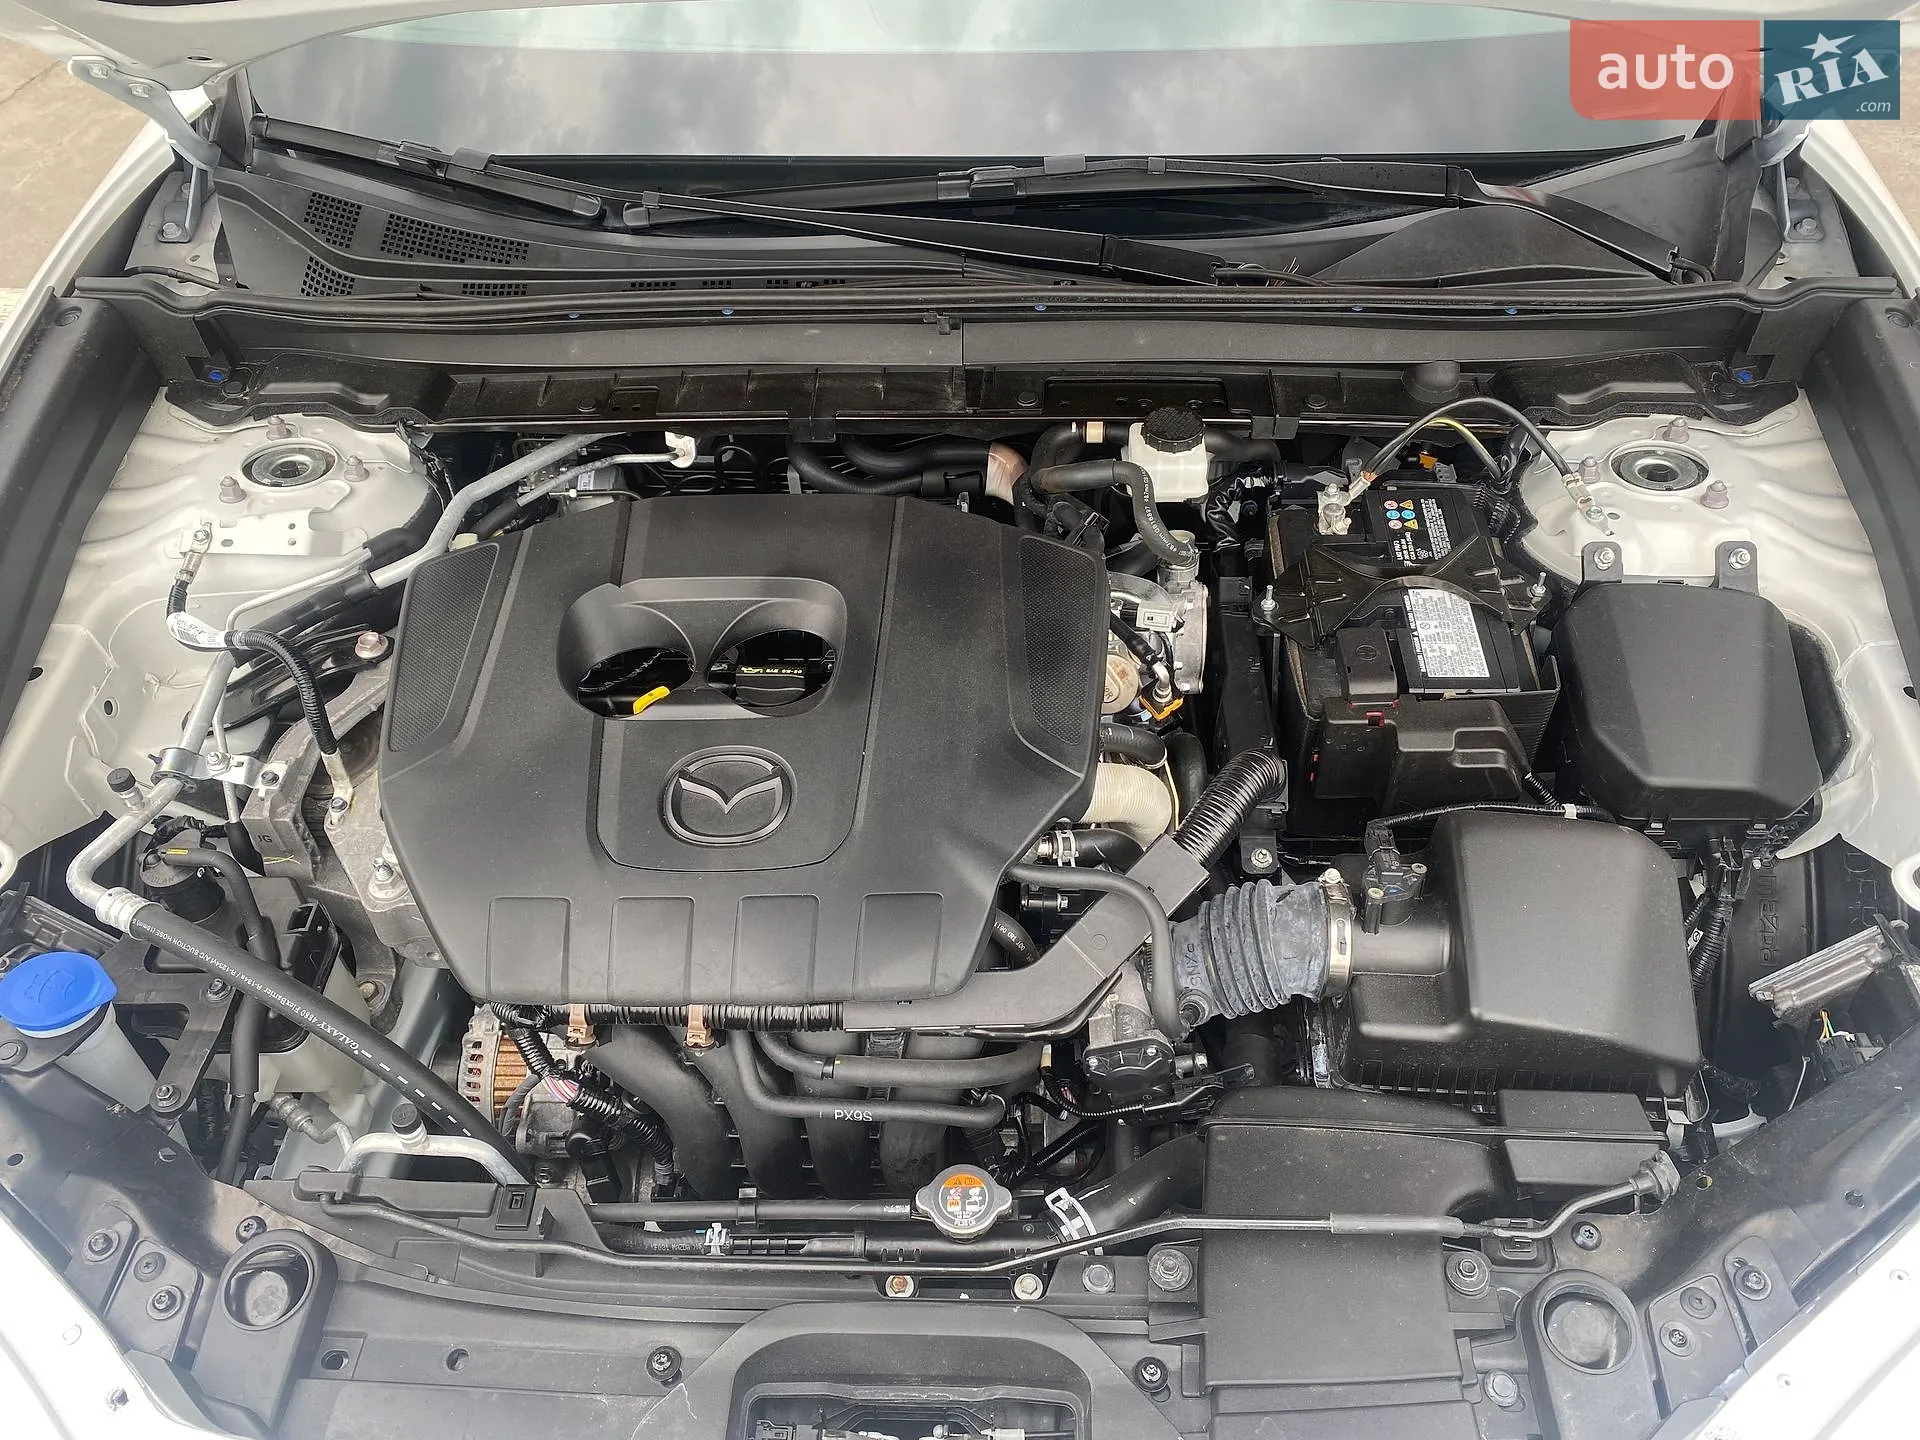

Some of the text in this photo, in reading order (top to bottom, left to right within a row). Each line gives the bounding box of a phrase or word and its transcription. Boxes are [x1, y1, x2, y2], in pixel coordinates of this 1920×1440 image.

[154, 928, 173, 943] HOSE
[262, 986, 300, 1014] FlexBarrier
[316, 1022, 360, 1050] GALAXY
[834, 1109, 873, 1121] PX9S
